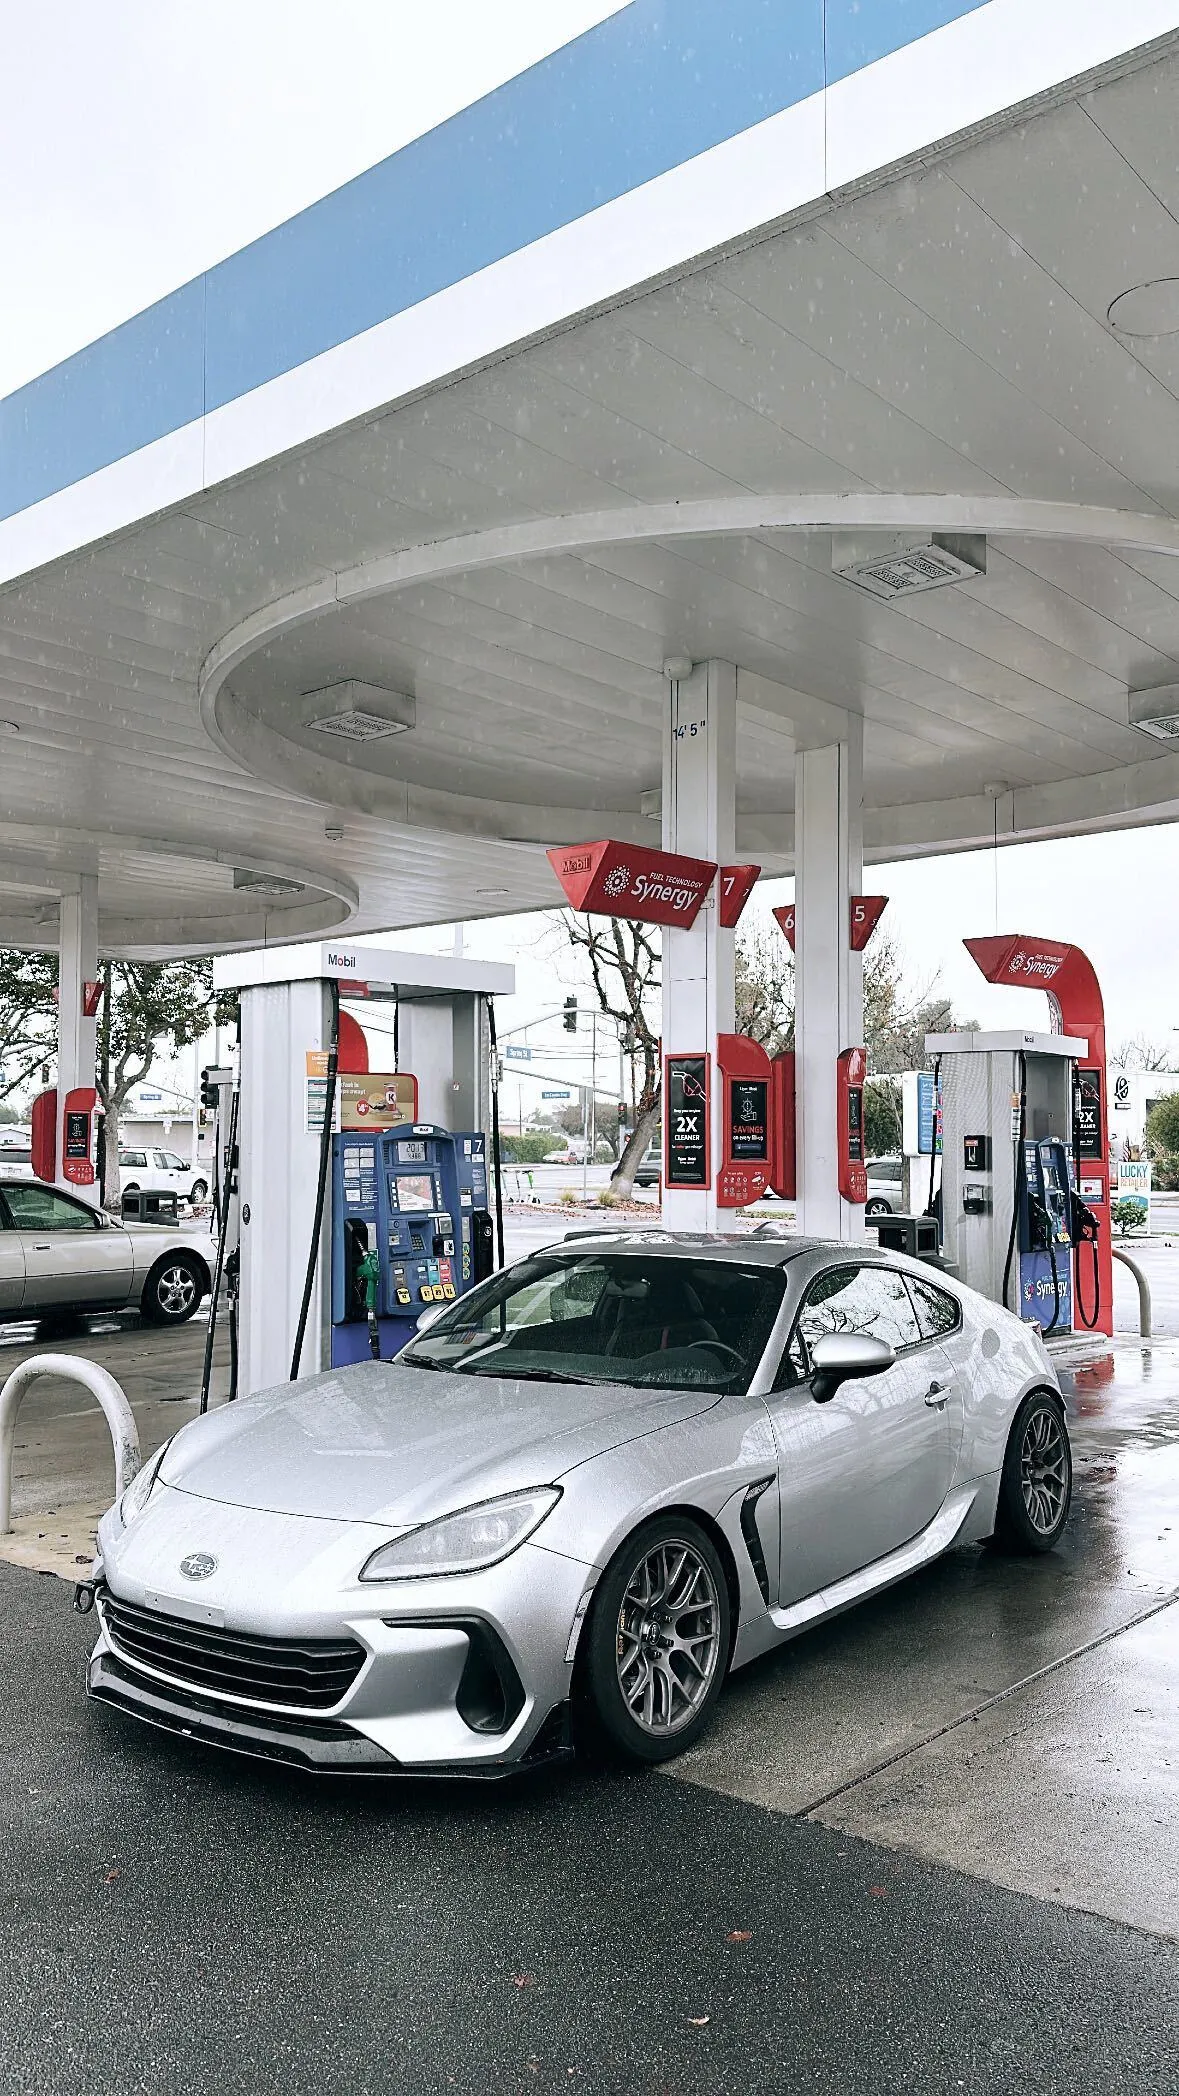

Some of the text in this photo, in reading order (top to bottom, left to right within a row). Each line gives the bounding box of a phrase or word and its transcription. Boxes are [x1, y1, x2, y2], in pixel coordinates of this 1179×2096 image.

[561, 855, 591, 874] Mobil
[649, 872, 704, 889] FUEL TECHNOLOGY
[723, 876, 736, 896] 7
[630, 875, 699, 911] Synergy
[784, 913, 795, 930] 6
[854, 905, 866, 922] 5
[328, 953, 356, 968] Mobil
[1023, 956, 1060, 979] Synergy
[388, 1094, 395, 1102] K
[676, 1116, 698, 1133] 2X
[1078, 1111, 1094, 1123] 2X
[732, 1125, 764, 1134] SAVINGS
[474, 1139, 483, 1153] 7
[1120, 1164, 1148, 1178] LUCKY
[1036, 1280, 1068, 1300] Synegy
